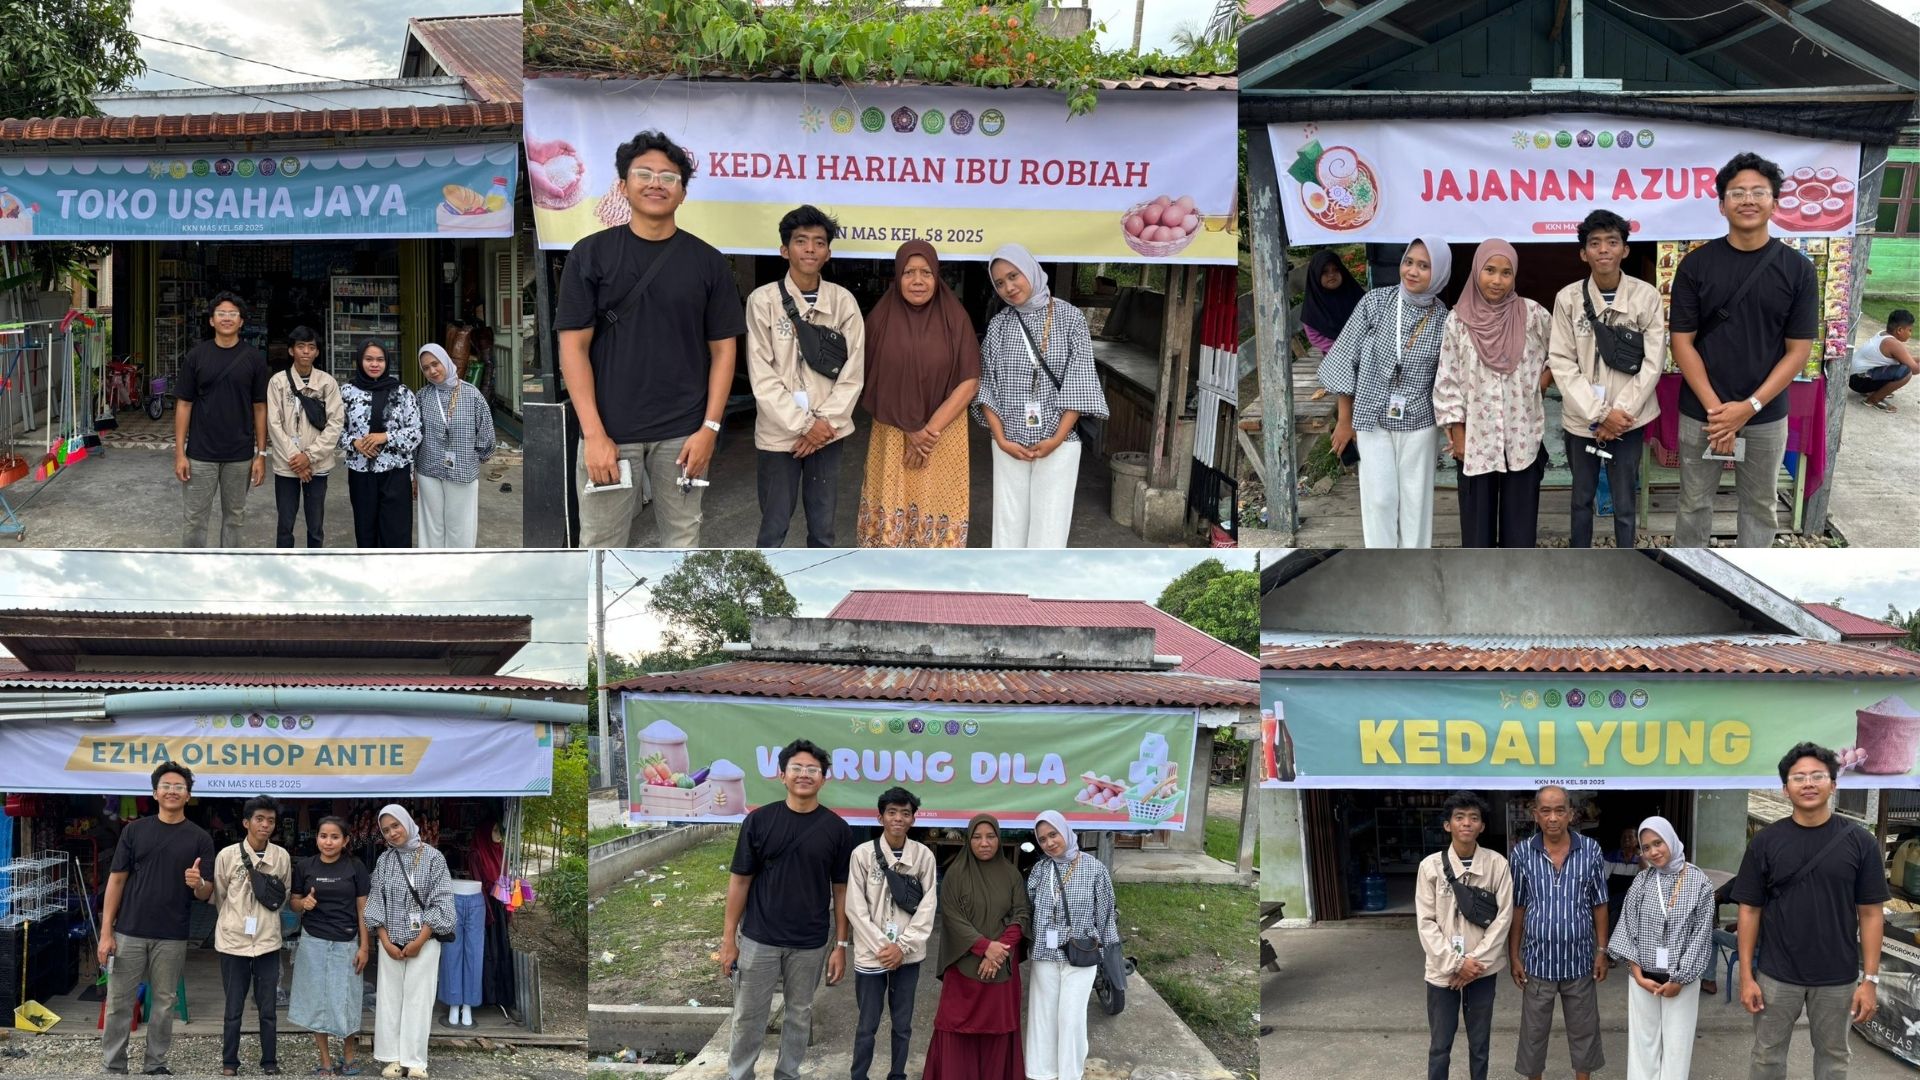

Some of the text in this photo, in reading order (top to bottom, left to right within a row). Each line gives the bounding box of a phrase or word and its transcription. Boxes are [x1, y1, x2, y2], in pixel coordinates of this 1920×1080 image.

[708, 152, 1150, 188] KEDAI HARIAN IBU ROBIAH
[1420, 166, 1719, 201] JAJANAN AZUR
[56, 183, 408, 220] TOKO USAHA JAYA
[182, 224, 198, 232] KKN
[199, 224, 217, 232] MAS
[245, 223, 264, 232] 2025
[851, 226, 887, 241] MAS
[891, 227, 943, 242] KEL.58
[947, 228, 984, 243] 2025
[1545, 222, 1562, 231] KKN
[91, 741, 404, 767] EZHA OLSHOP ANTIE
[1359, 719, 1752, 766] KEDAI YUNG
[755, 744, 1067, 785] WRUNG DILA
[207, 779, 302, 789] KKN MAS KEL.58 2025
[1866, 1020, 1913, 1051] ERKELAS
